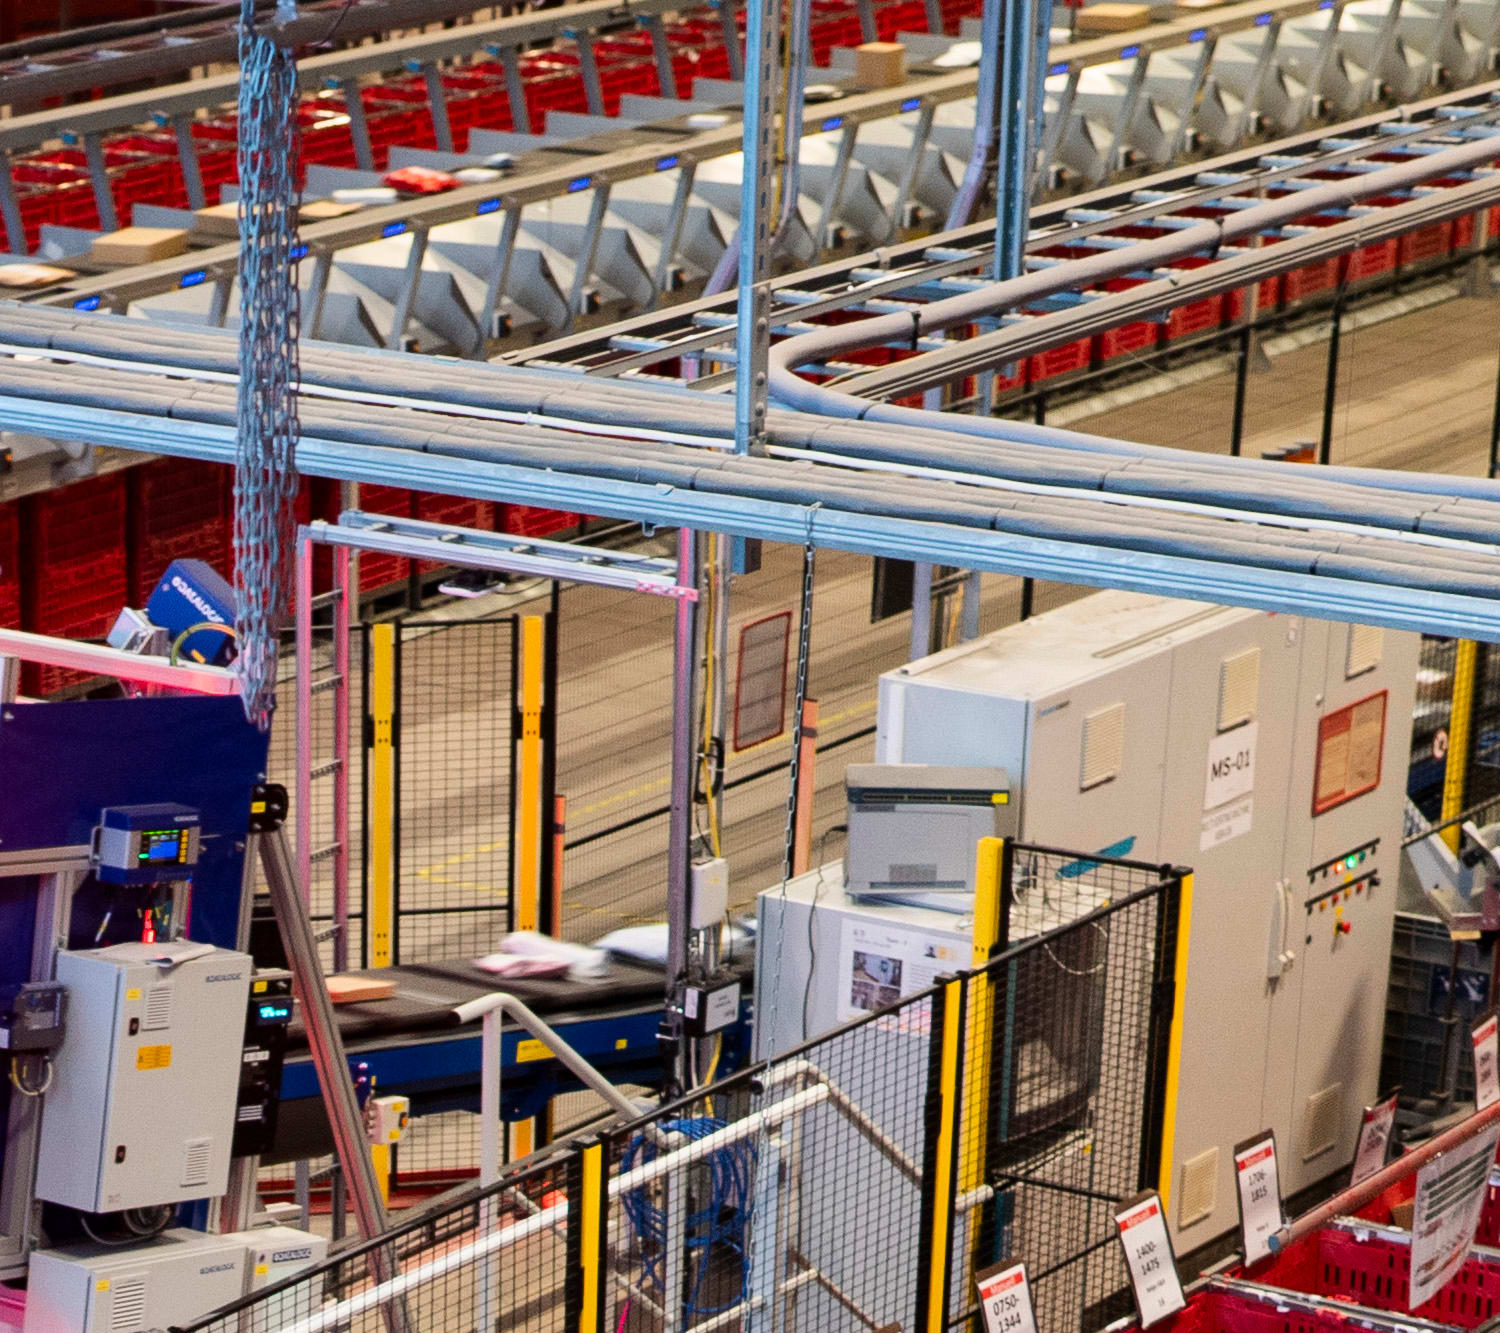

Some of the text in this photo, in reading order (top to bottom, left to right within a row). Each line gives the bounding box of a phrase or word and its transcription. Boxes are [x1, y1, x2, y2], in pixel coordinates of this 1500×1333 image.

[1210, 750, 1250, 781] MS-01
[993, 1293, 1020, 1317] 0750-
[998, 1312, 1022, 1333] 1344
